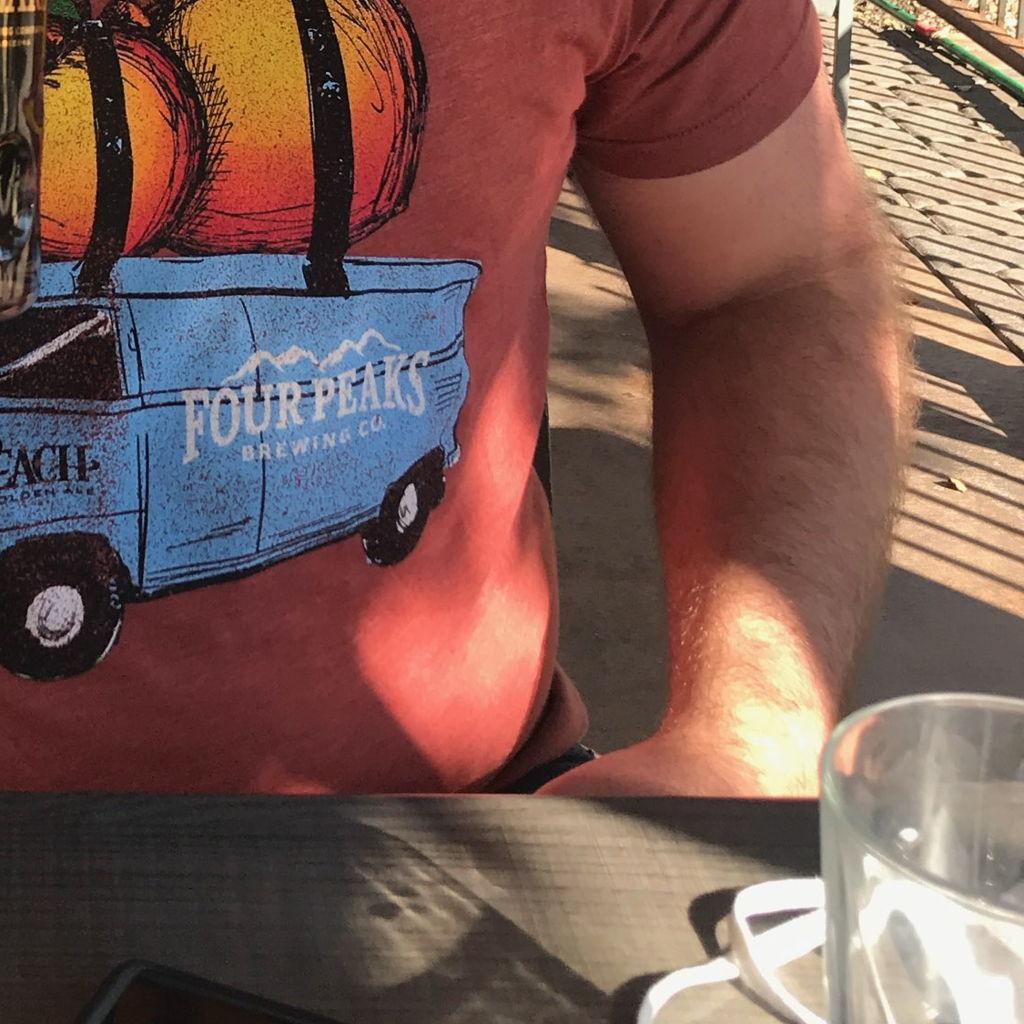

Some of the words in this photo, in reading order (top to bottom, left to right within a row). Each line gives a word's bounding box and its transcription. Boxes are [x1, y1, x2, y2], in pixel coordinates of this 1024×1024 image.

[182, 385, 304, 464] FOUR
[312, 350, 432, 422] PEAKS
[242, 436, 351, 462] BREWING
